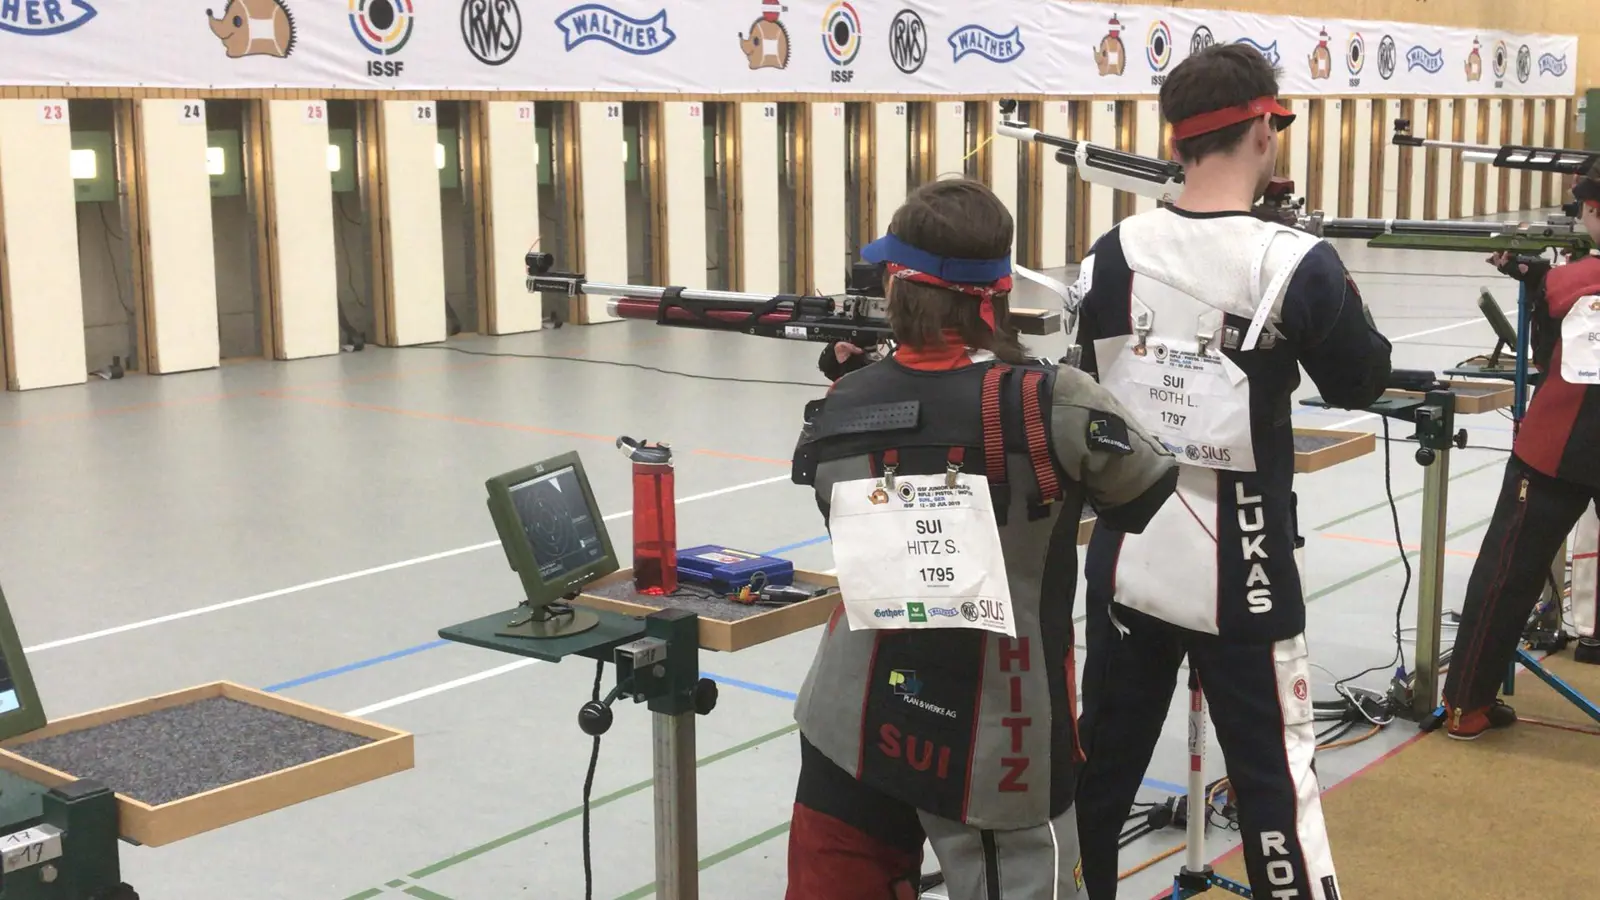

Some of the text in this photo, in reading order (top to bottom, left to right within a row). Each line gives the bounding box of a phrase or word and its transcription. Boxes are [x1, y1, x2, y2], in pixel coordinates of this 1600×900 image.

[573, 13, 657, 47] WALTHER
[894, 18, 922, 67] RWS
[958, 31, 1013, 57] WALTHER
[367, 60, 404, 77] ISSF
[831, 70, 854, 83] ISSF
[44, 105, 63, 120] 23
[184, 105, 200, 118] 24
[307, 106, 323, 119] 25
[417, 107, 432, 119] 26
[519, 107, 530, 118] 27
[608, 106, 619, 118] 28
[1163, 375, 1184, 389] SUI
[1150, 388, 1198, 408] ROTH L.
[1160, 411, 1187, 427] 1797
[1201, 445, 1232, 462] SIUS
[916, 520, 942, 534] SUI
[907, 539, 960, 555] HITZ S.
[1235, 481, 1273, 614] LUKAS
[919, 567, 955, 582] 1795
[979, 599, 1004, 621] SIUS
[903, 695, 919, 706] PLAN
[924, 702, 945, 716] WERKE
[945, 710, 957, 719] AG
[998, 636, 1032, 793] HITZ
[879, 724, 950, 779] SUI
[21, 842, 44, 862] 17
